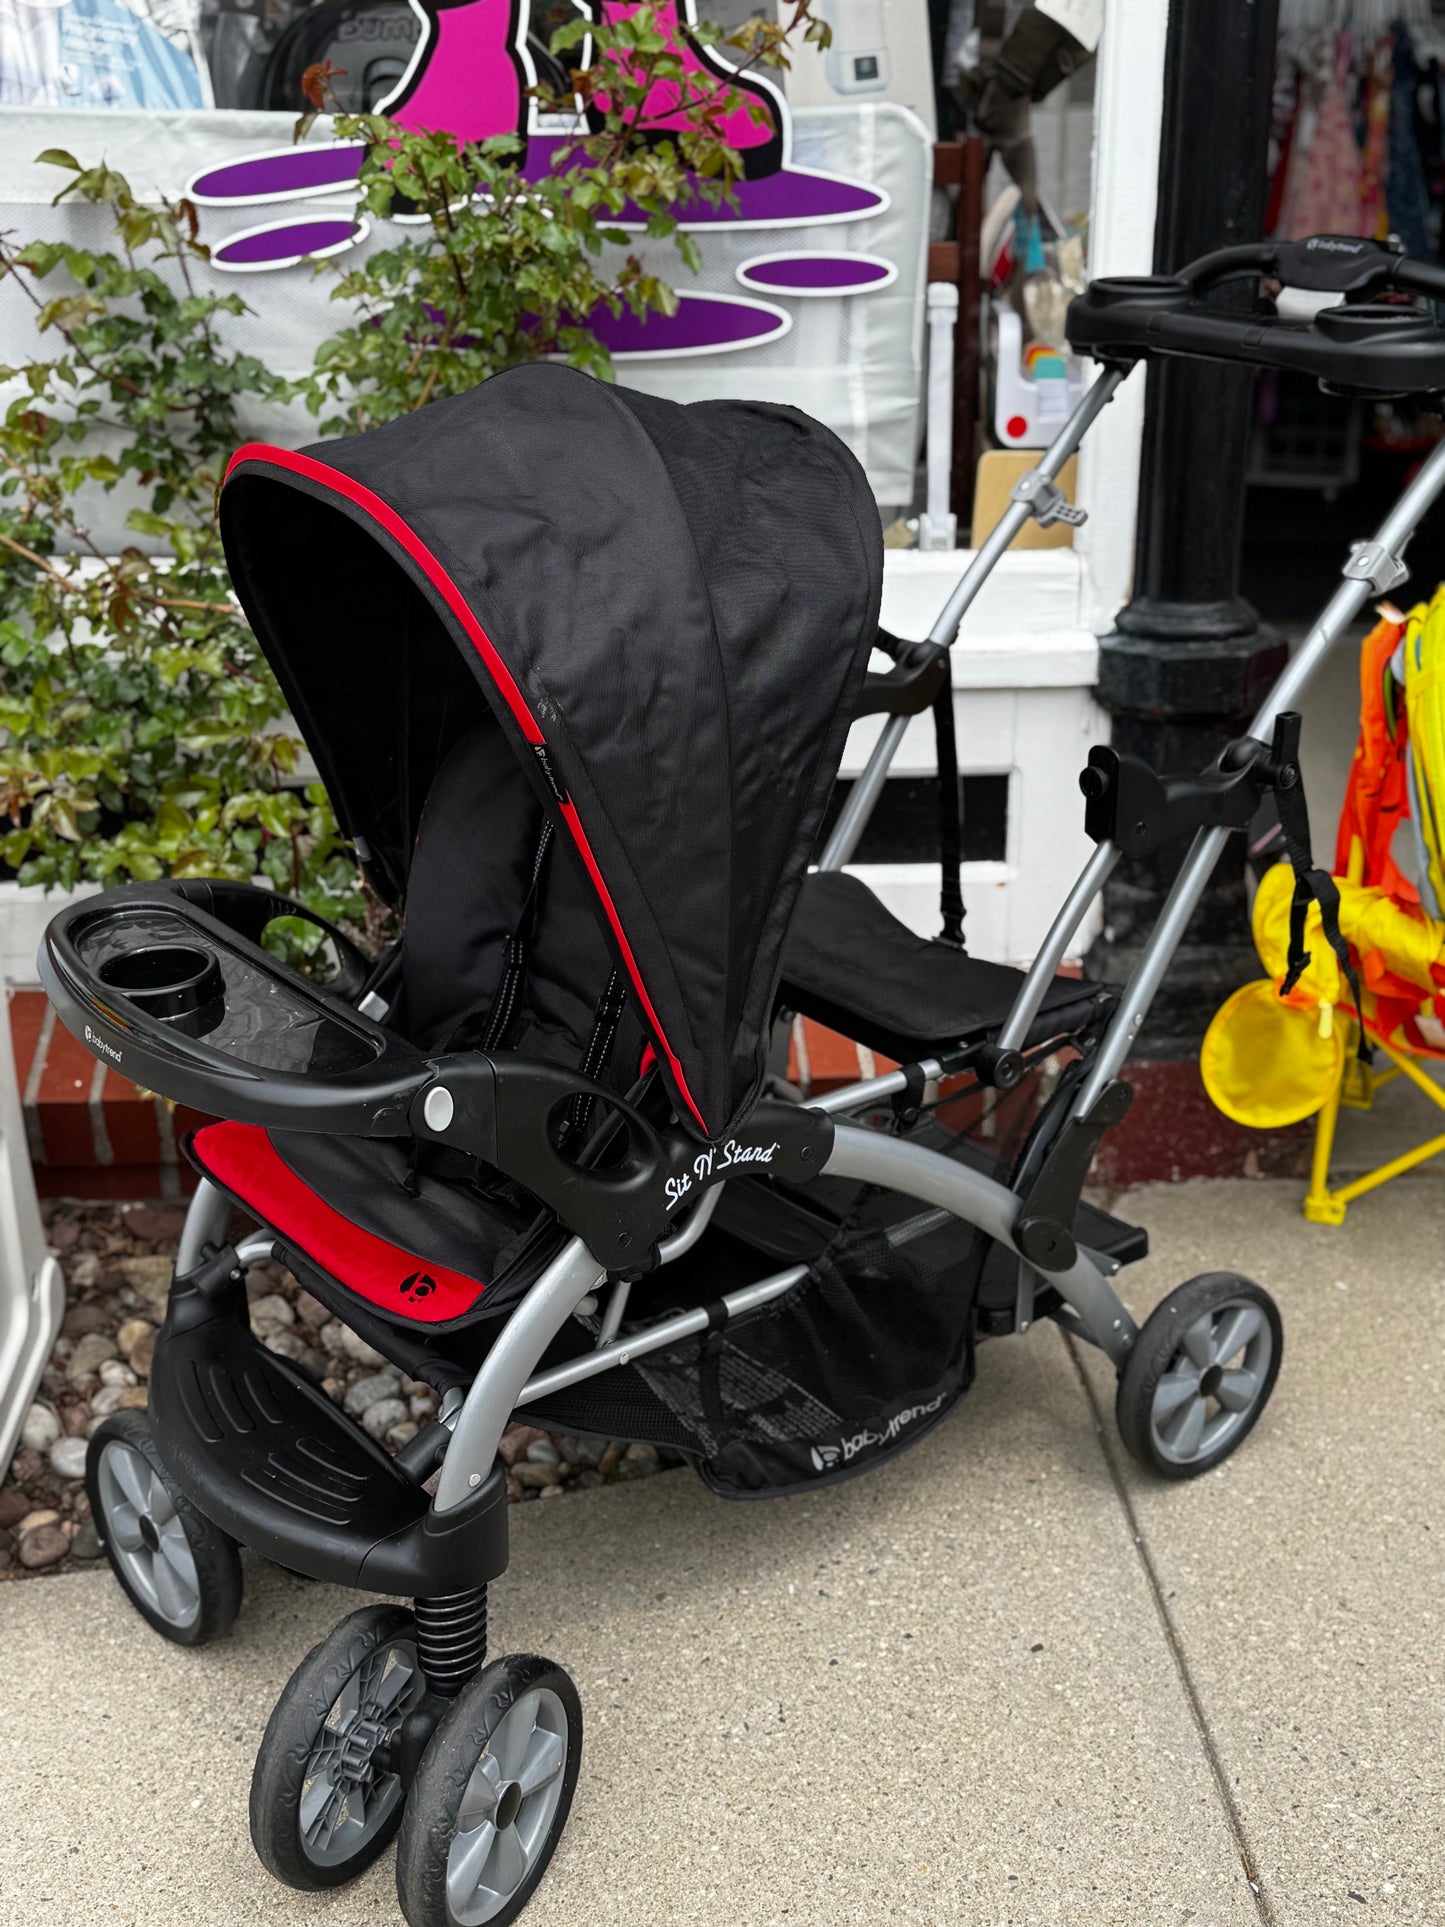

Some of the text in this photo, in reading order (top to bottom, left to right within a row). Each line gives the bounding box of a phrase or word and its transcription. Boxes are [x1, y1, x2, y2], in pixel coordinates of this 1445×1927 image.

[92, 1030, 122, 1063] babytrend
[664, 1177, 692, 1211] Sit
[716, 1139, 777, 1170] Stand
[840, 1395, 943, 1460] babytrend
